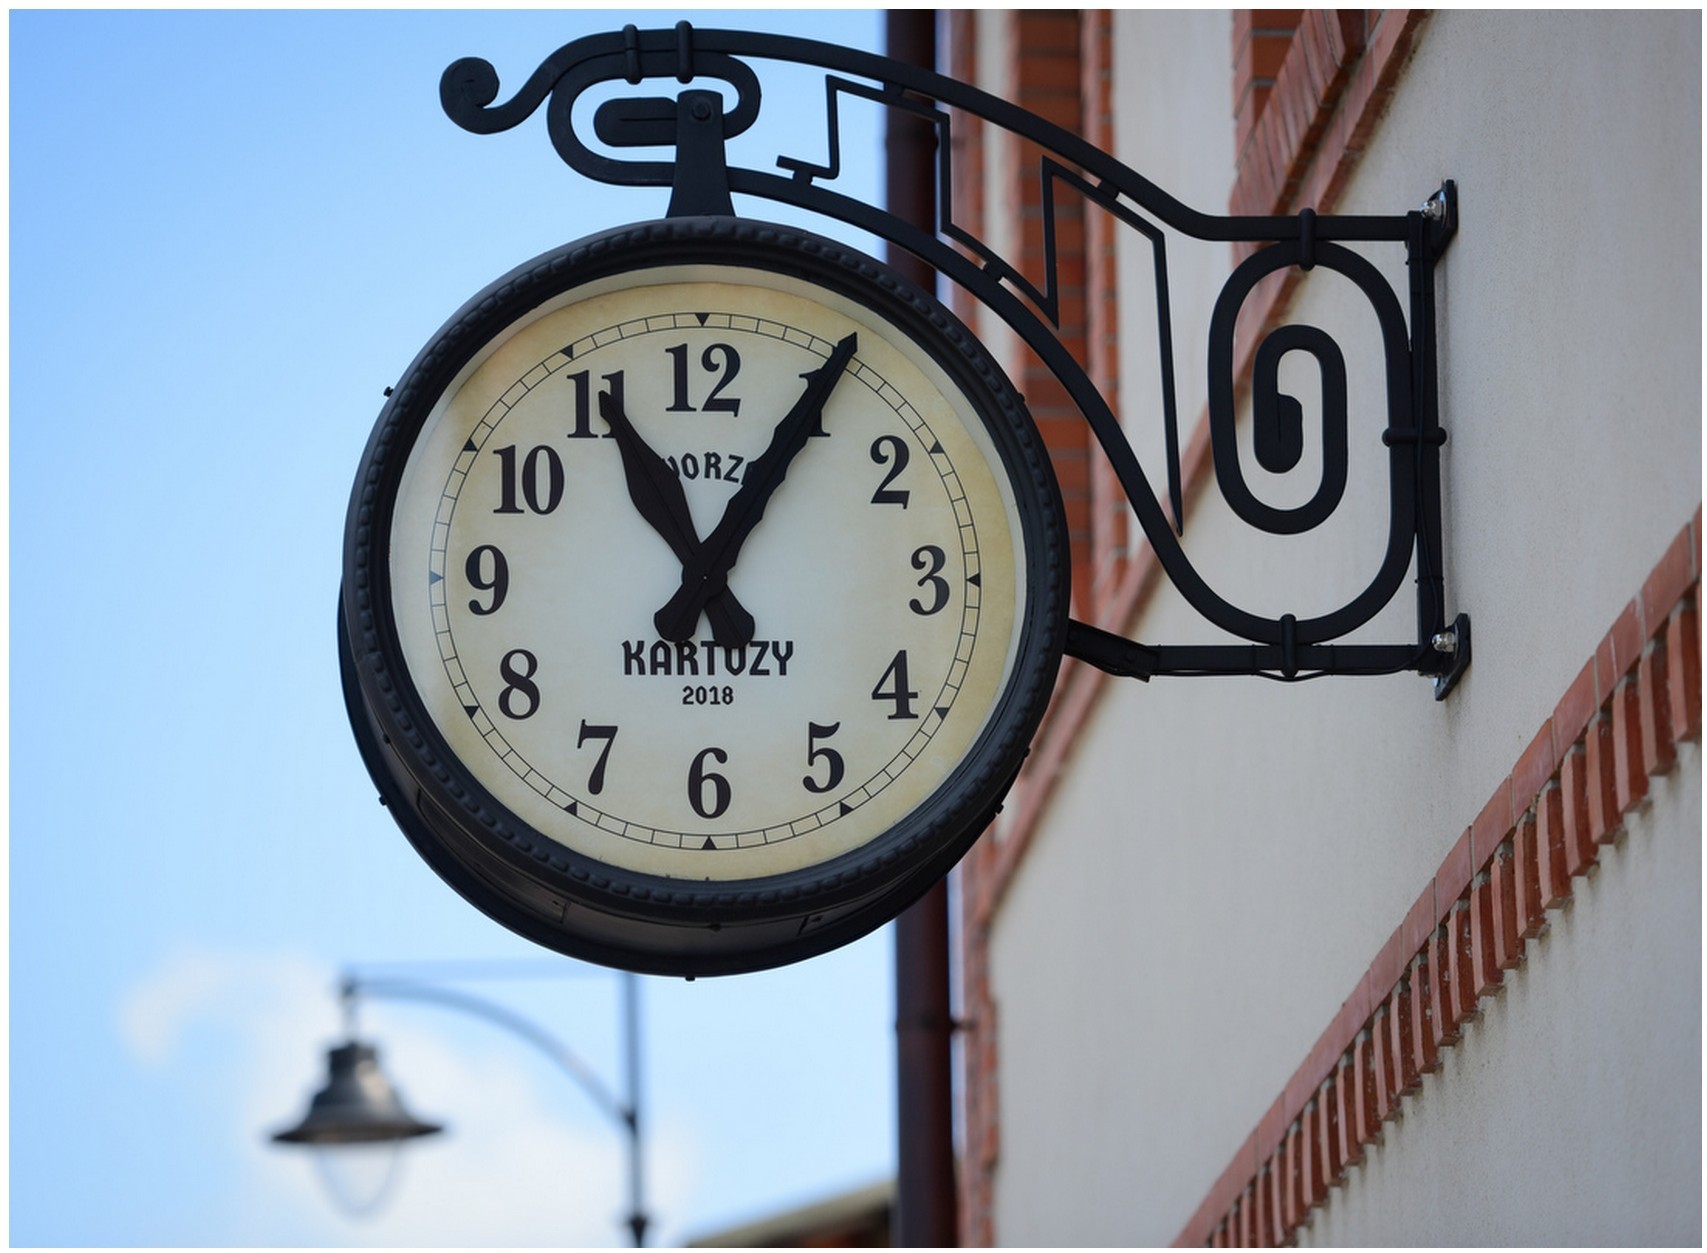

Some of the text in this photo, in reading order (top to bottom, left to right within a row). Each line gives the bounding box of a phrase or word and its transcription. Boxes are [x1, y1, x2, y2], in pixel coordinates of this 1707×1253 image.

[665, 343, 741, 417] 12
[493, 444, 565, 515] 10
[870, 435, 910, 510] 2
[465, 544, 509, 616] 9
[909, 544, 950, 615] 3
[498, 648, 541, 720] 8
[622, 640, 794, 676] KARTUZY
[871, 649, 919, 720] 4
[682, 685, 734, 705] 2018
[577, 719, 619, 795] 7
[688, 747, 732, 820] 6
[802, 721, 845, 794] 5
